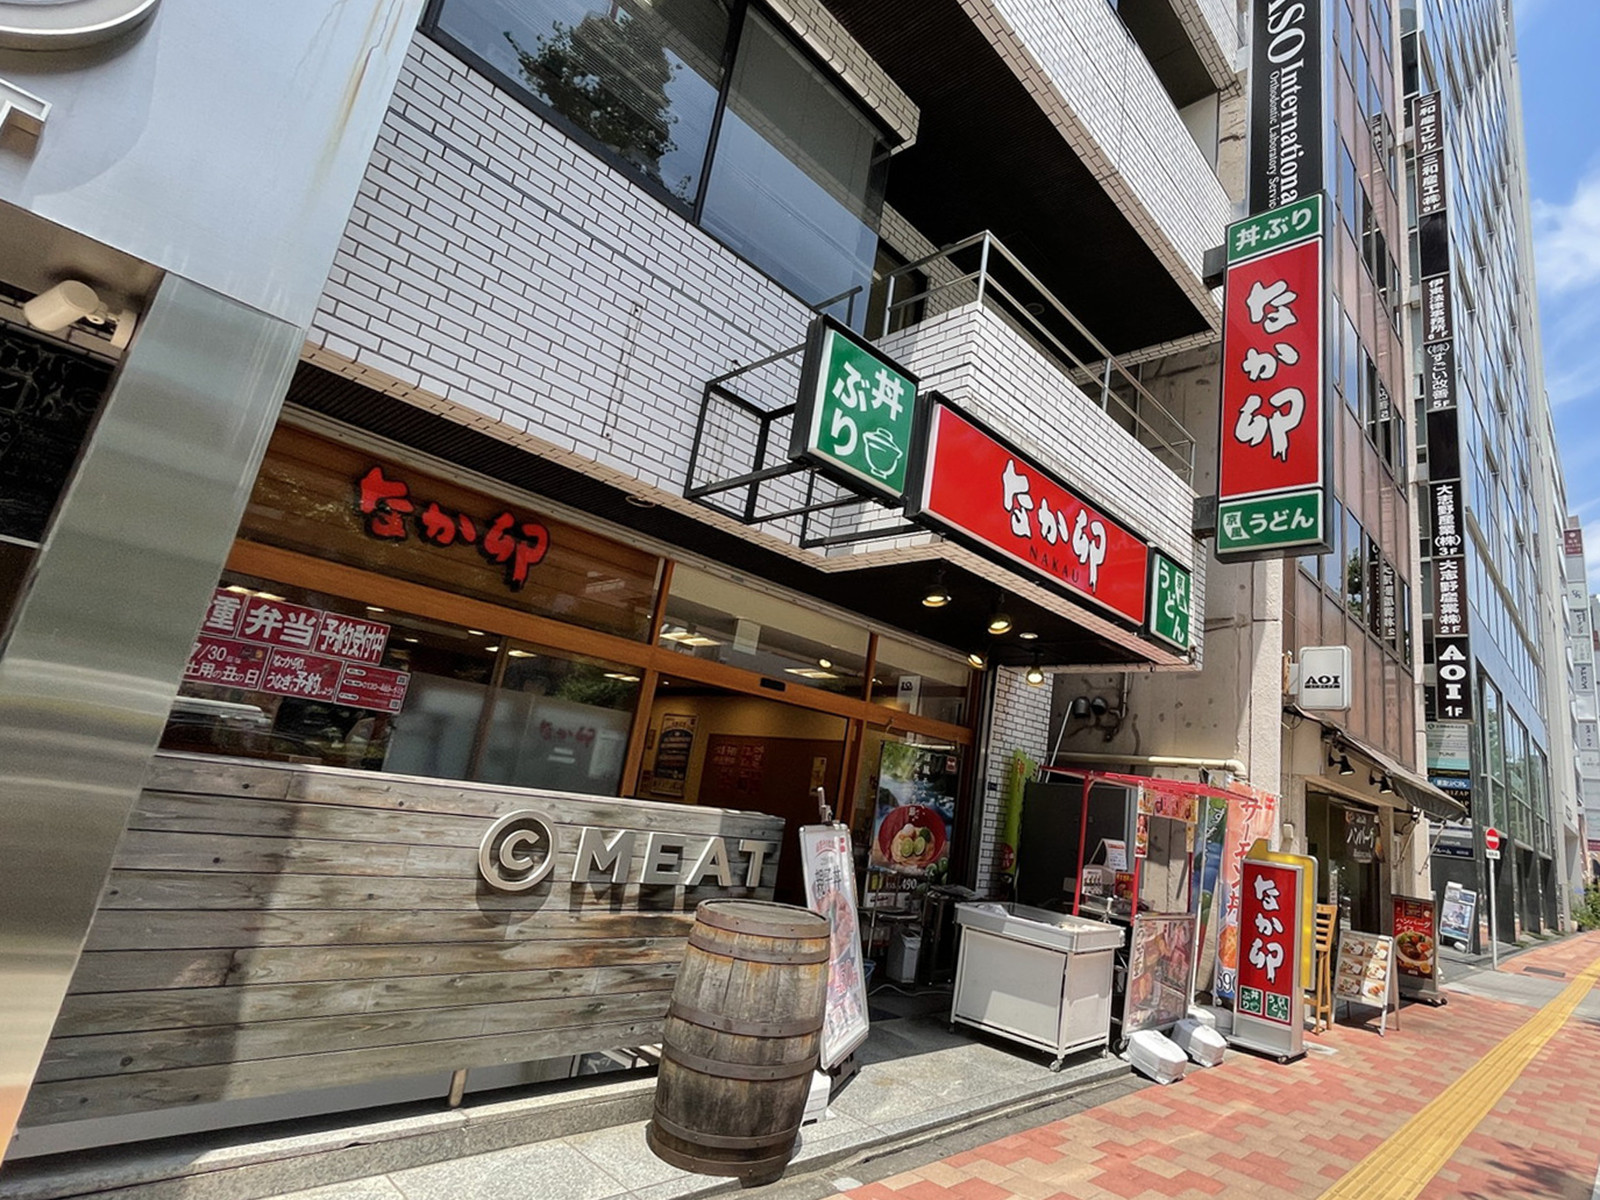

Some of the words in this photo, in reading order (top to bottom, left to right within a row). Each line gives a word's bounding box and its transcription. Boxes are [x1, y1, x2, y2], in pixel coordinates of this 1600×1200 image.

[1268, 71, 1280, 124] Orthodontic
[1267, 123, 1280, 175] Laboratory
[1280, 58, 1305, 206] Internationa
[1235, 208, 1312, 251] 丼ぶり
[1233, 279, 1305, 463] なか卯
[832, 361, 905, 456] 丼ぶり
[357, 466, 552, 592] なか卯
[1002, 459, 1108, 594] なか卯
[1226, 513, 1243, 539] 京風
[1249, 507, 1315, 535] うどん
[1029, 545, 1079, 583] NAKAU
[1160, 562, 1185, 643] うどん
[1440, 625, 1462, 634] 2F
[245, 605, 318, 646] 弁当
[320, 619, 387, 660] 予約受付中
[186, 661, 260, 685] 土用の丑の日
[1305, 675, 1340, 685] AOI
[1438, 644, 1466, 700] AOI
[1445, 705, 1463, 717] 1F
[572, 826, 778, 888] MEAT
[1249, 873, 1285, 985] なか卯
[1396, 917, 1431, 929] ハンバーグ
